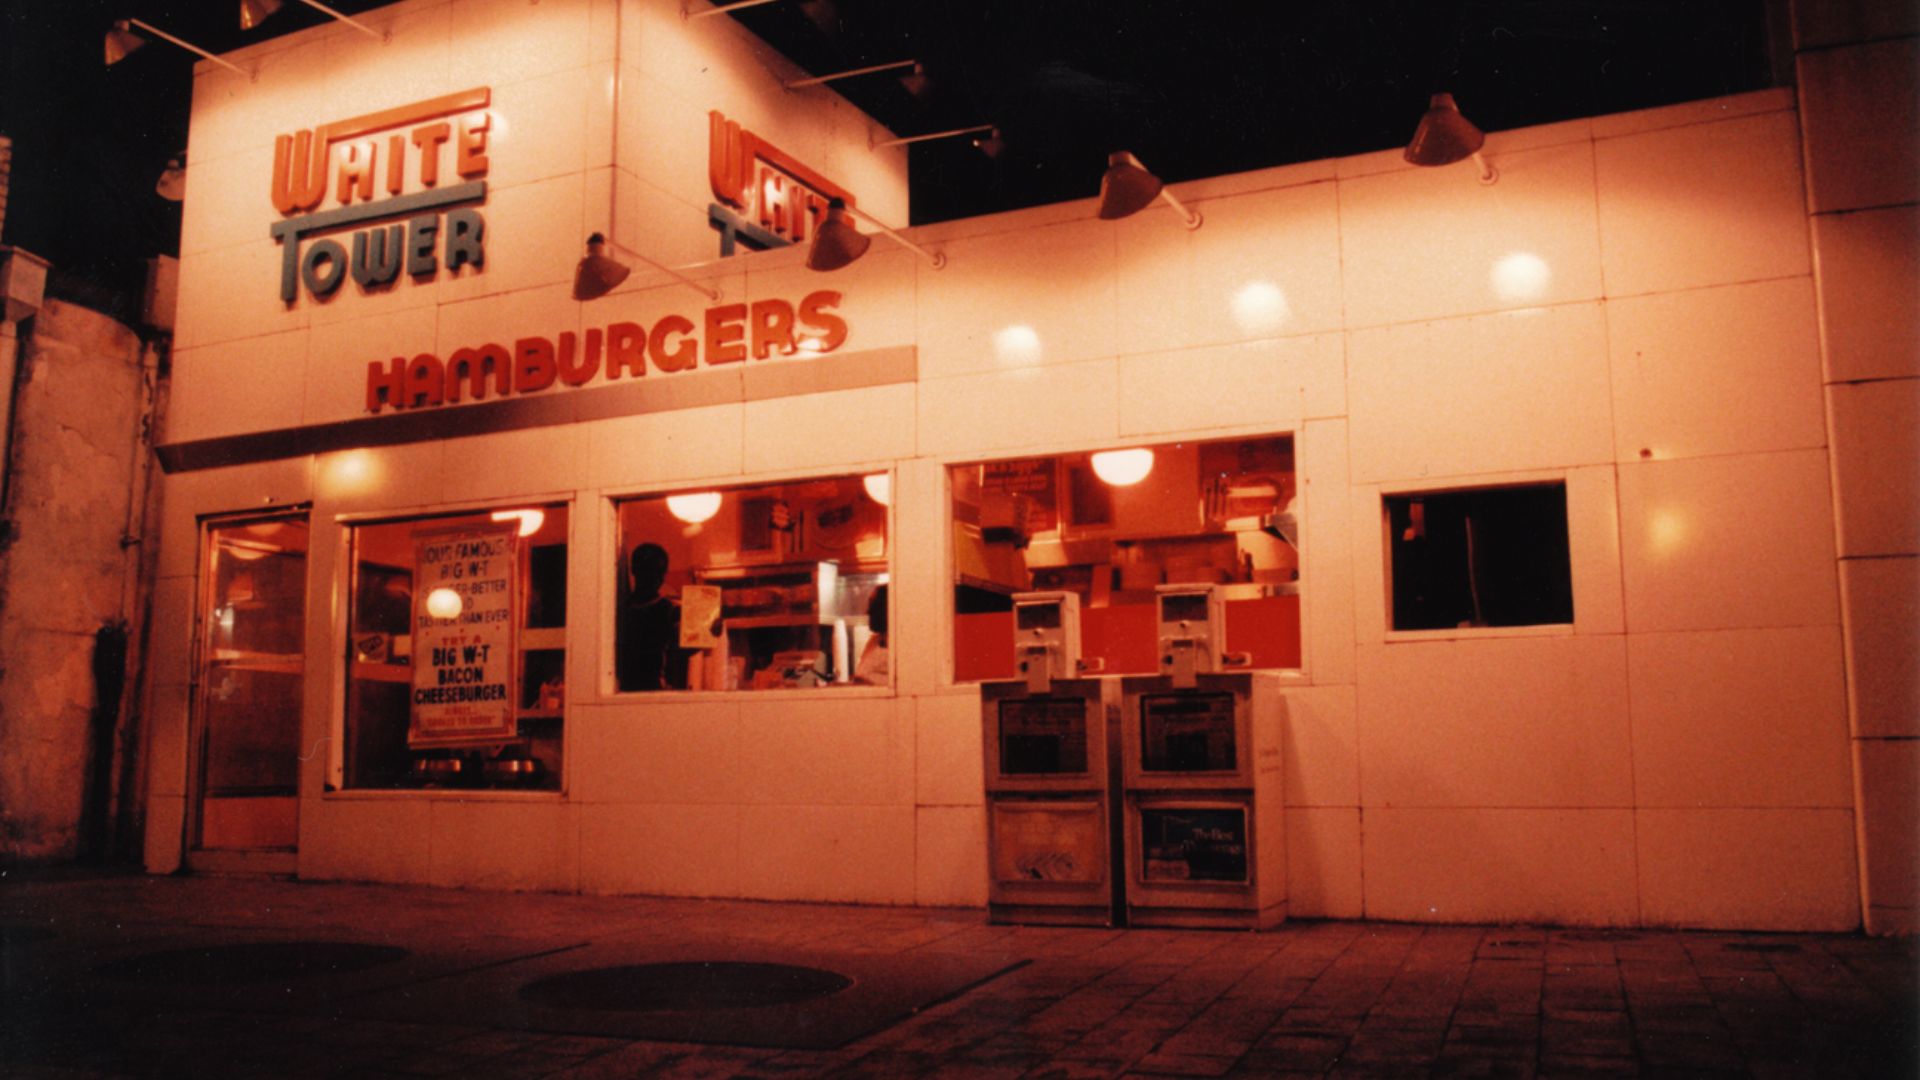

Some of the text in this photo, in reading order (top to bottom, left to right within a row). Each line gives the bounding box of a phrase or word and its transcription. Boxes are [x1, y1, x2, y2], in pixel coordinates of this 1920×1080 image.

[271, 85, 491, 217] WHITE
[708, 110, 856, 243] WHIT
[270, 180, 488, 311] TOWER
[365, 290, 848, 412] HAMBURGERS
[485, 609, 509, 624] EVER
[432, 644, 490, 666] BIG W-T
[438, 666, 484, 686] BACON
[414, 683, 507, 705] CHEESEBURGER
